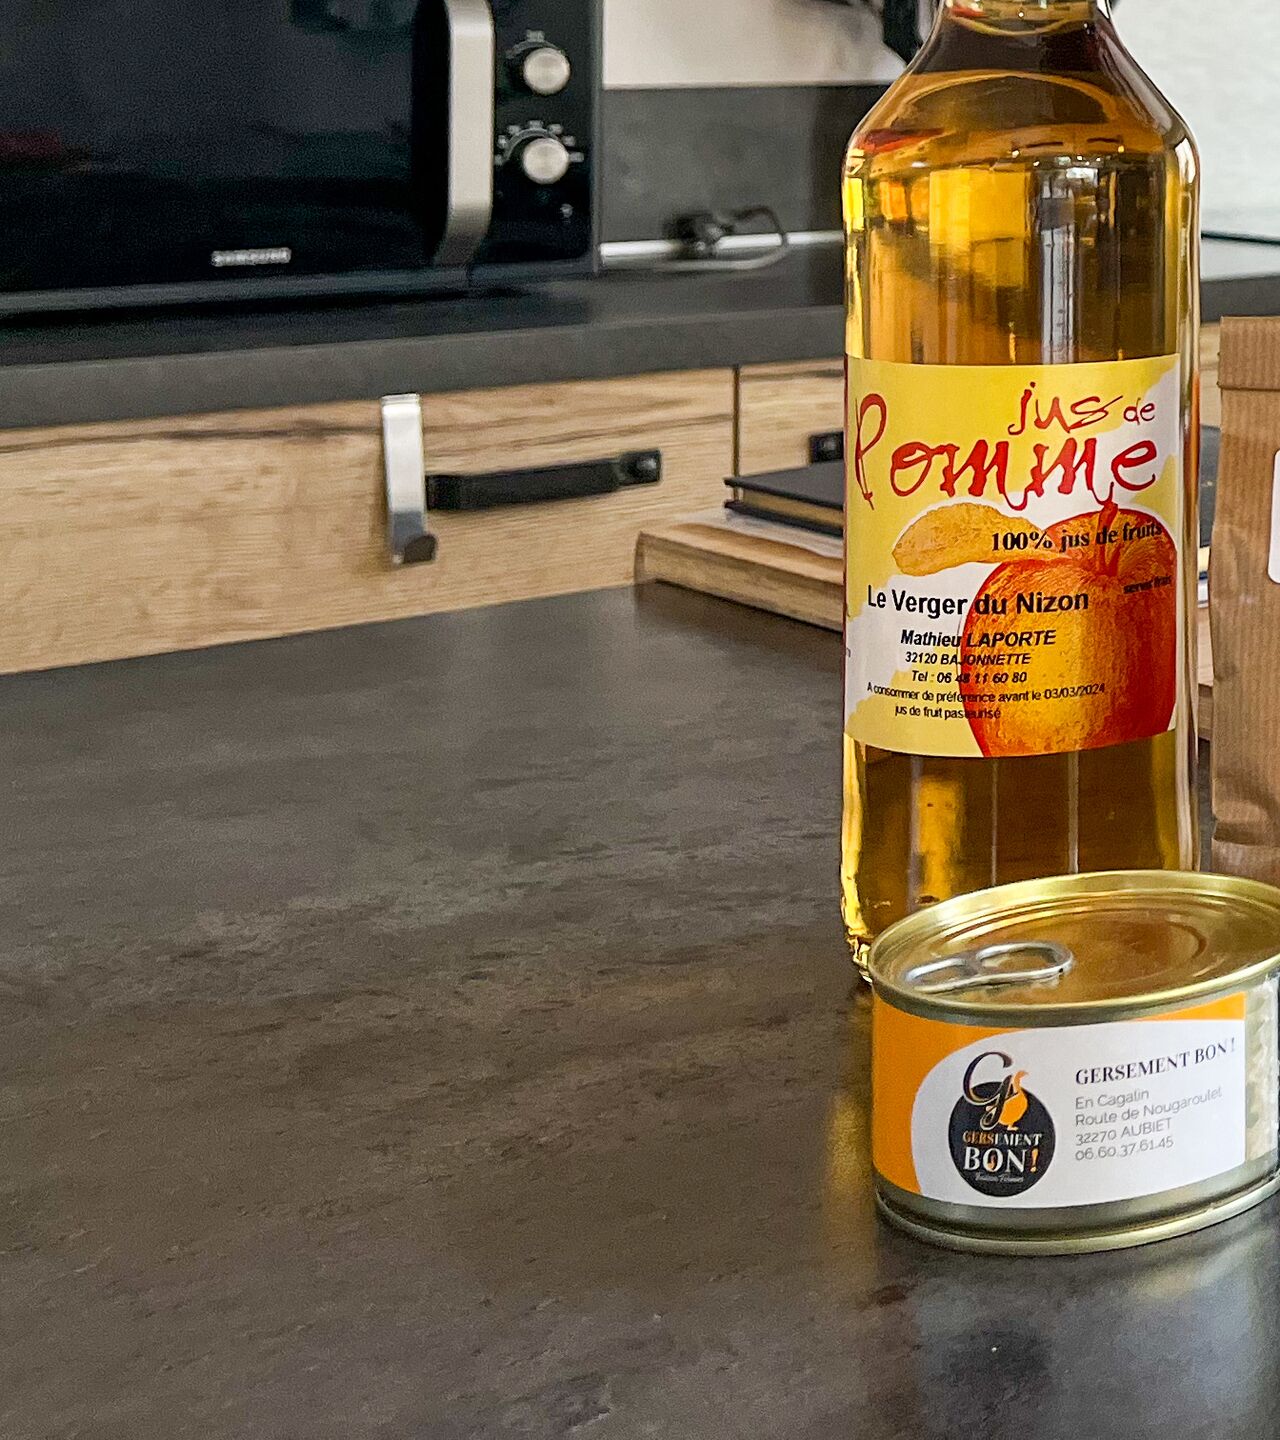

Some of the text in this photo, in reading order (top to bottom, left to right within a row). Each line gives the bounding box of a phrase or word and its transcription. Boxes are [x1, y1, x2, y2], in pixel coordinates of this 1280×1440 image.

[1007, 381, 1156, 435] jus de
[855, 393, 1158, 510] Pomme
[992, 531, 1053, 552] 100%
[1059, 529, 1091, 553] jus
[1096, 528, 1119, 545] de
[867, 584, 1089, 620] Le Verger du Nizon
[900, 629, 1057, 648] Mathieu LAPORTE
[905, 651, 1032, 666] 32120 BAJONNETTE
[911, 670, 928, 682] Tel
[936, 672, 952, 684] 06
[992, 672, 1009, 684] 60
[1011, 671, 1027, 683] 80
[867, 681, 873, 693] A
[921, 690, 934, 701] de
[998, 690, 1029, 703] avant
[1031, 689, 1041, 701] le
[909, 705, 921, 717] de
[1075, 1050, 1191, 1086] GERSEMENT
[1075, 1089, 1150, 1110] En Cagalin
[1075, 1112, 1118, 1127] Route
[1121, 1109, 1140, 1121] de
[1076, 1117, 1173, 1147] 32270 AUBIET
[1075, 1134, 1175, 1161] 06.60.37.61.45
